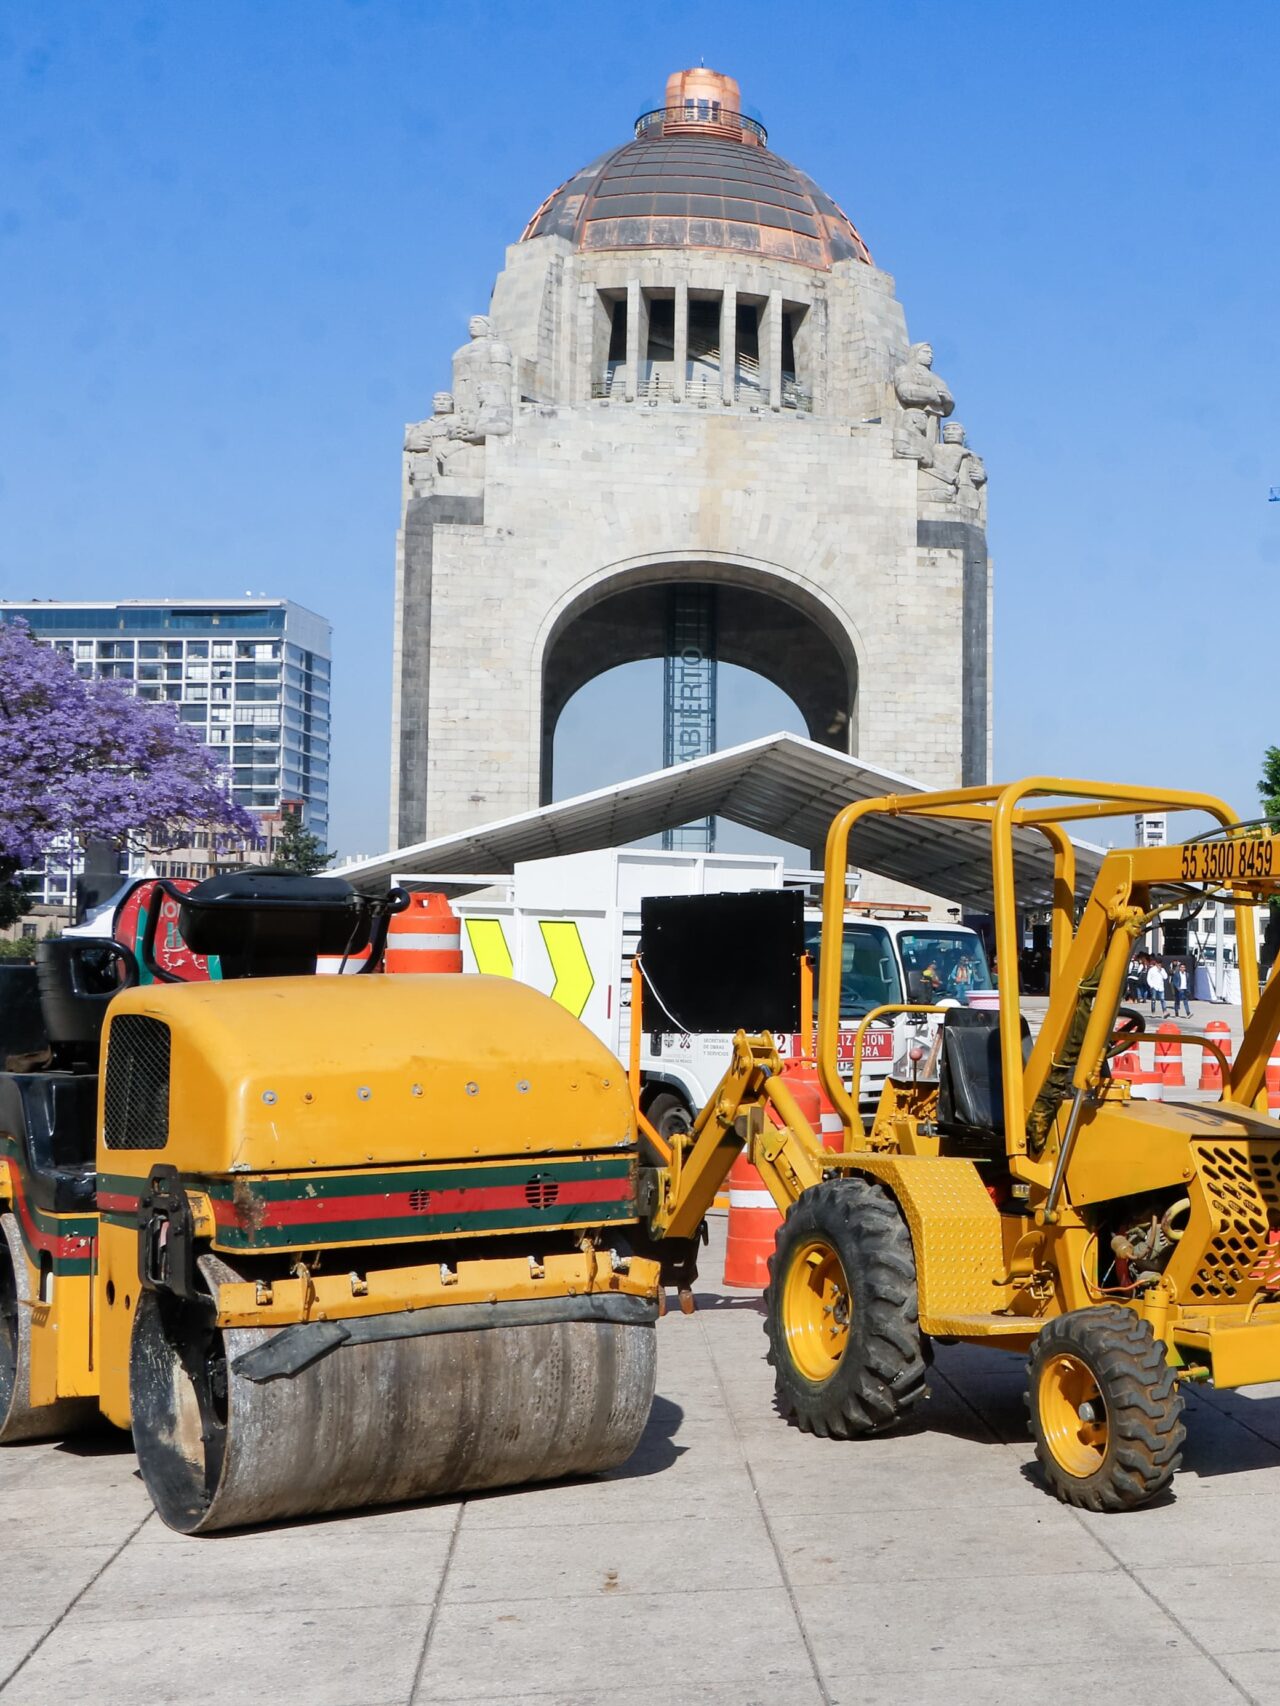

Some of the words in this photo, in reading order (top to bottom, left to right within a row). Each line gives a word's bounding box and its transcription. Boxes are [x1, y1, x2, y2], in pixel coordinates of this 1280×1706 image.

[1181, 844, 1198, 880] 55
[1201, 842, 1235, 879] 3500
[1238, 839, 1273, 878] 8459
[777, 1034, 786, 1054] 2
[853, 1047, 880, 1057] BRA
